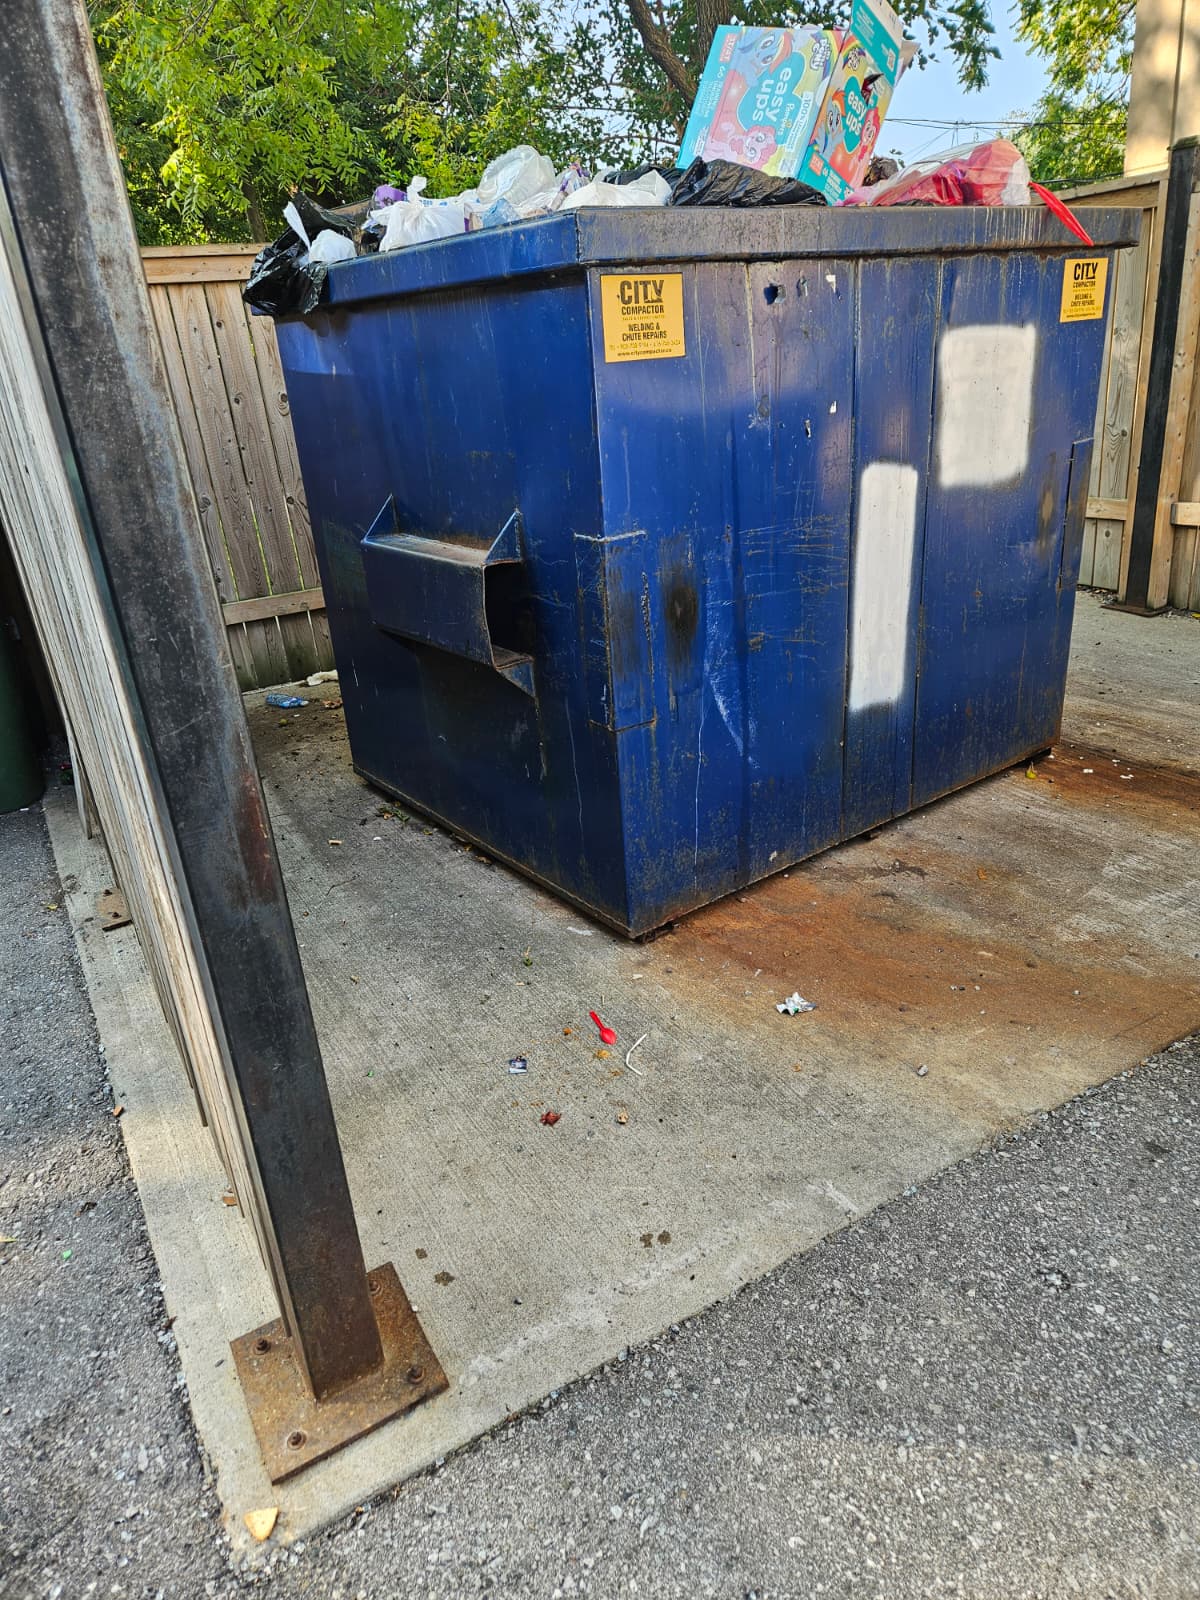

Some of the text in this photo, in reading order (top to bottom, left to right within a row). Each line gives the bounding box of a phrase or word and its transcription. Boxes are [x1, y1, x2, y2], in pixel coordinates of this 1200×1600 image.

[751, 79, 775, 122] ups
[764, 67, 793, 122] easy
[847, 91, 867, 121] easy
[845, 112, 862, 136] ups
[1074, 262, 1098, 280] CITY
[620, 279, 665, 305] CITY
[621, 305, 664, 315] COMPACTOR
[622, 330, 668, 342] CHUTE REPAIRS
[628, 322, 661, 332] WELDING &
